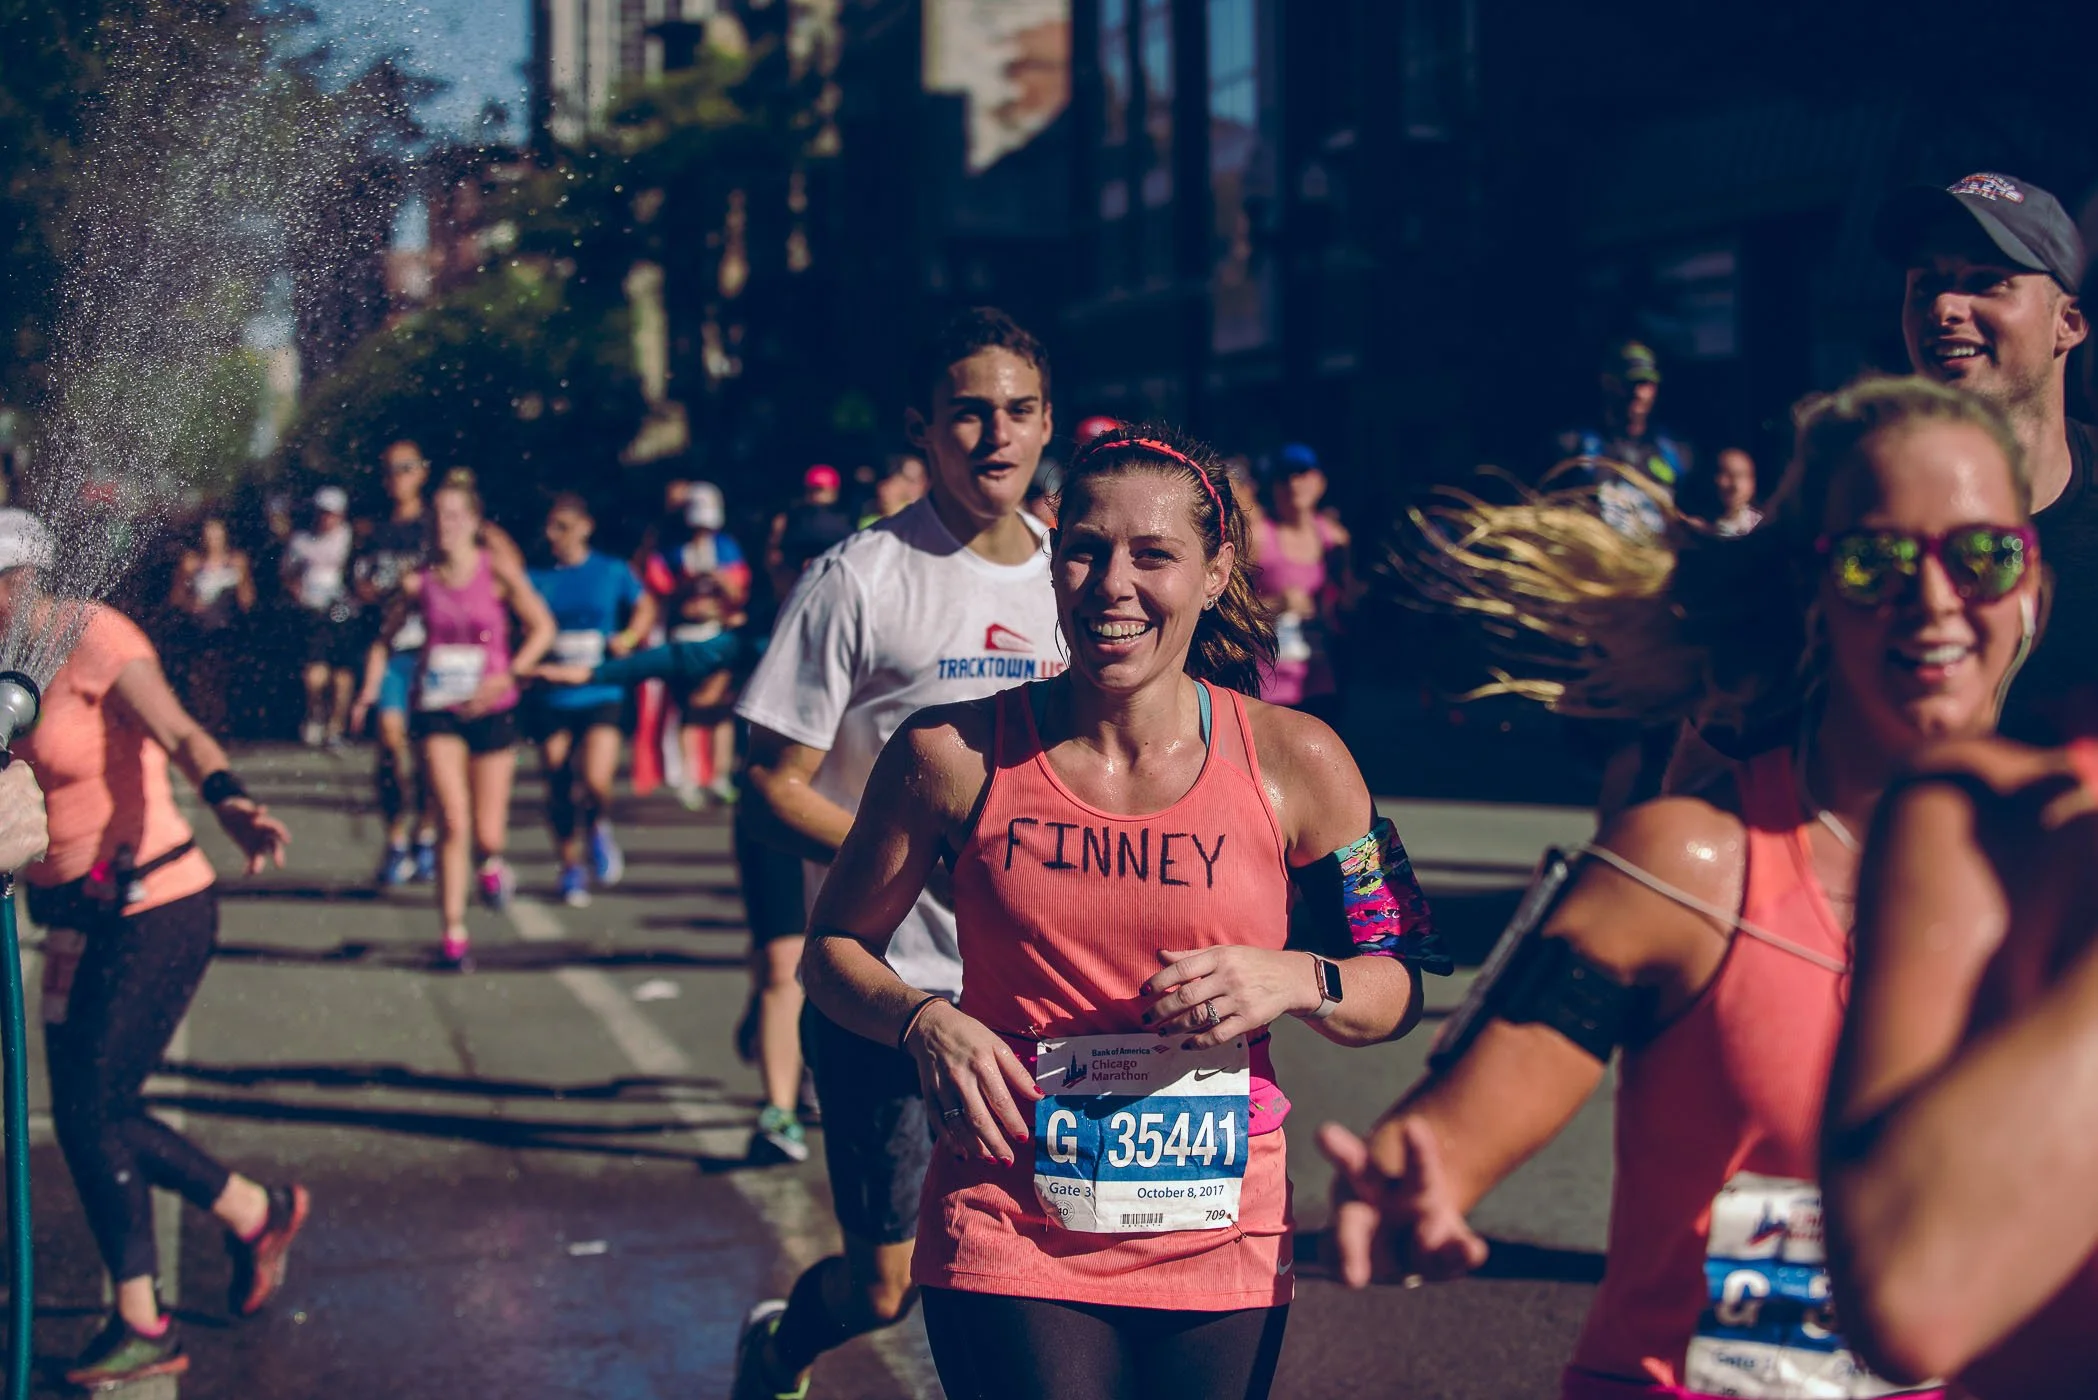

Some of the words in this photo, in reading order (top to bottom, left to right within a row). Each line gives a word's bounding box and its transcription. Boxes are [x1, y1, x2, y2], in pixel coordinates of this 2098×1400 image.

[938, 657, 1035, 679] TRACKTOWN
[1004, 817, 1226, 889] FINNEY
[1091, 1049, 1111, 1057] Bank
[1111, 1048, 1119, 1056] of
[1119, 1047, 1150, 1055] America
[1091, 1059, 1137, 1071] Chicago
[1091, 1071, 1148, 1081] Marathon
[1046, 1109, 1078, 1165] G
[1108, 1110, 1236, 1168] 35441
[1049, 1182, 1081, 1197] Gate
[1137, 1186, 1185, 1199] October
[1187, 1187, 1197, 1200] 8,
[1199, 1184, 1224, 1198] 2017
[1205, 1209, 1226, 1222] 709
